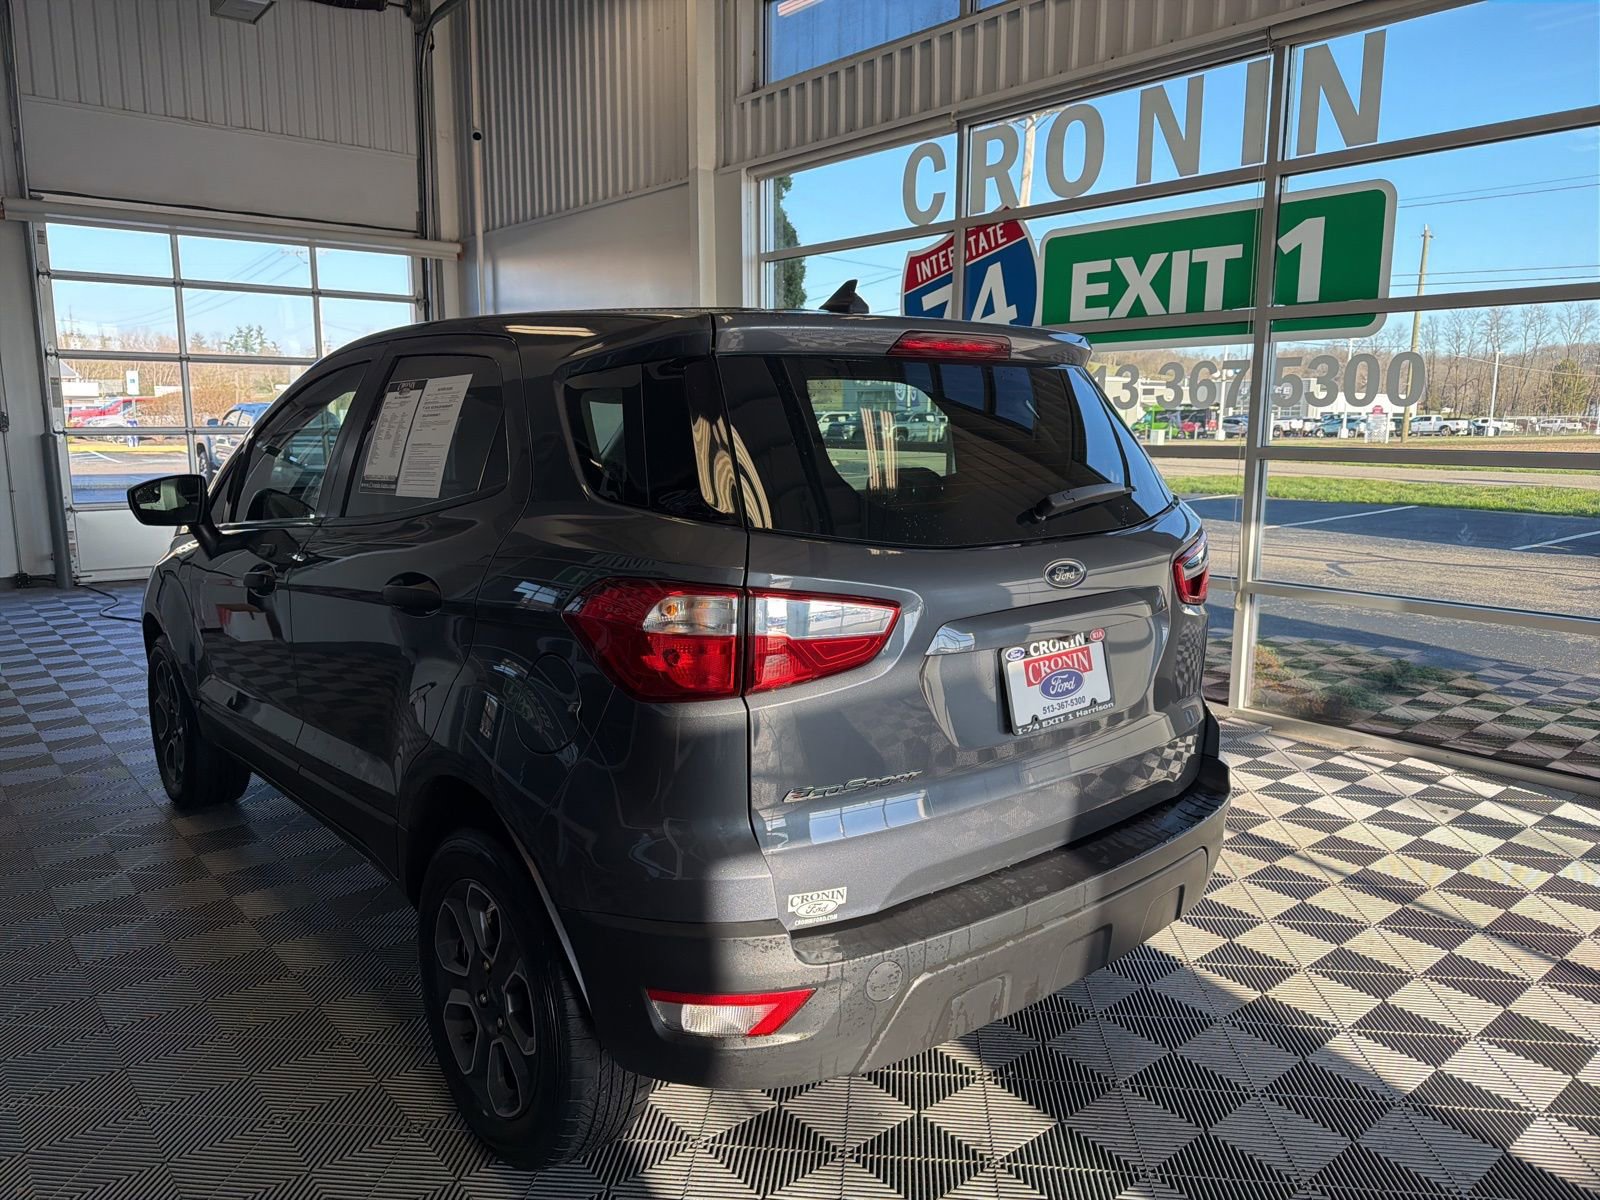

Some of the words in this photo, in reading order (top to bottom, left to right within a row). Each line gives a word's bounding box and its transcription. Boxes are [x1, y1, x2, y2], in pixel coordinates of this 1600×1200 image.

[902, 29, 1387, 226] CRONIN
[1070, 243, 1243, 321] EXIT
[1277, 216, 1326, 302] 1
[921, 261, 1018, 325] 74
[1029, 632, 1086, 657] CRONIN
[1092, 630, 1104, 639] KIA
[1028, 650, 1090, 684] CRONIN
[1049, 674, 1077, 695] Ford
[1042, 695, 1086, 715] 513-367-5300
[1017, 722, 1040, 735] I-74
[1042, 715, 1066, 728] EXIT
[1076, 702, 1114, 717] Harrison
[790, 888, 846, 908] CRONIN
[805, 902, 829, 914] Ford
